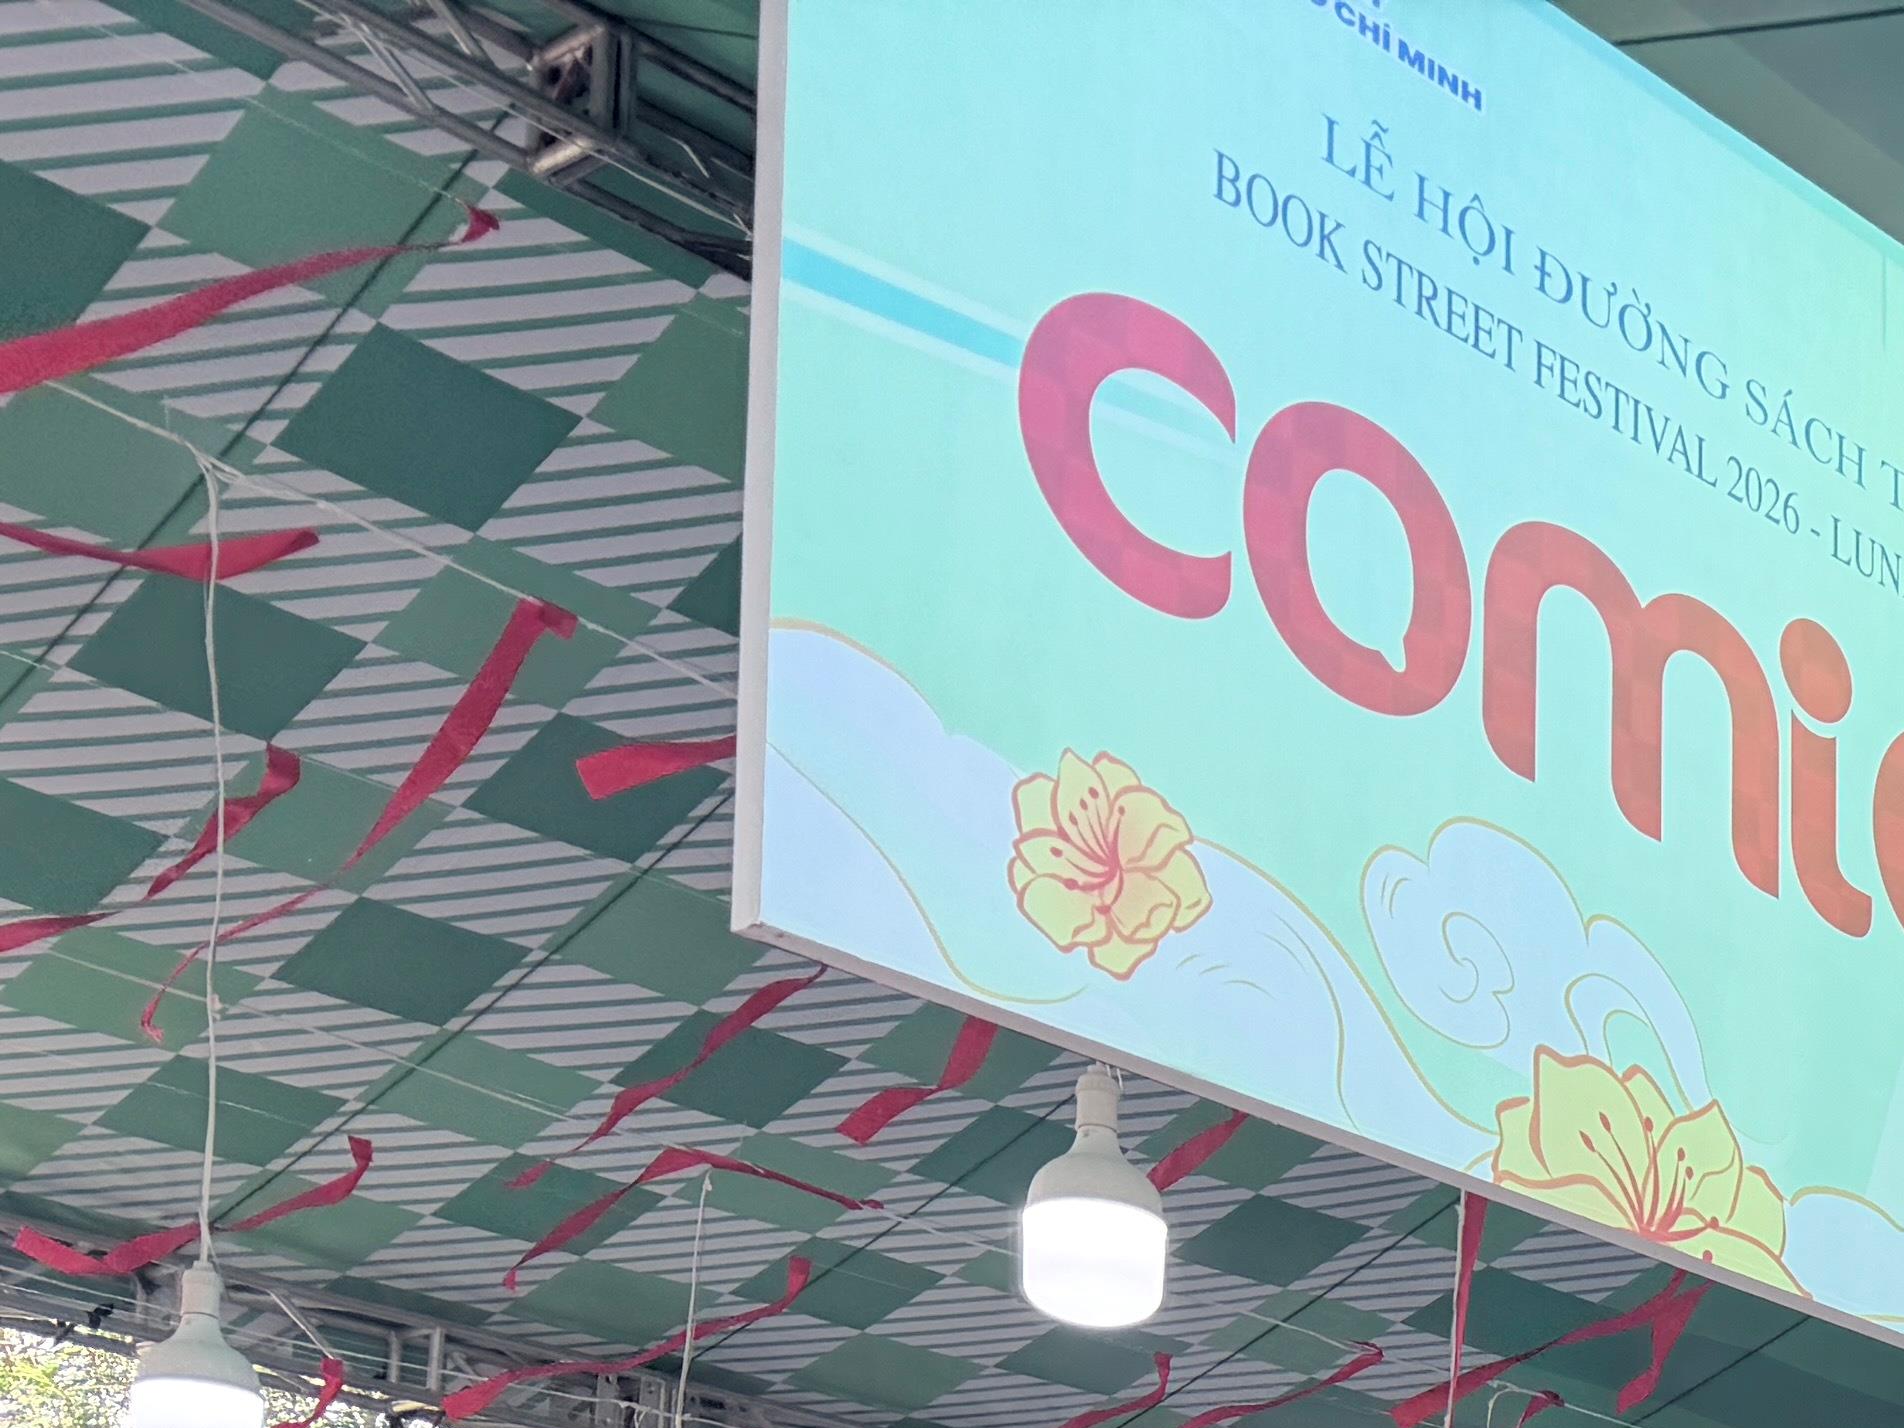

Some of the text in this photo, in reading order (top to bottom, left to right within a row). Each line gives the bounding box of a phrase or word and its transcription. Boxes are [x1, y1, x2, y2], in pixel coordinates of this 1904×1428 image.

[1397, 36, 1482, 112] MINH
[1212, 148, 1348, 275] BOOK
[1361, 238, 1524, 373] STREET
[1532, 339, 1718, 489] FESTIVAL
[1726, 455, 1801, 535] 2026
[1321, 112, 1396, 202] LỄ
[1413, 171, 1516, 277] HỘI
[1534, 245, 1730, 402] ĐƯỜNG
[1744, 378, 1867, 490] SÁCH
